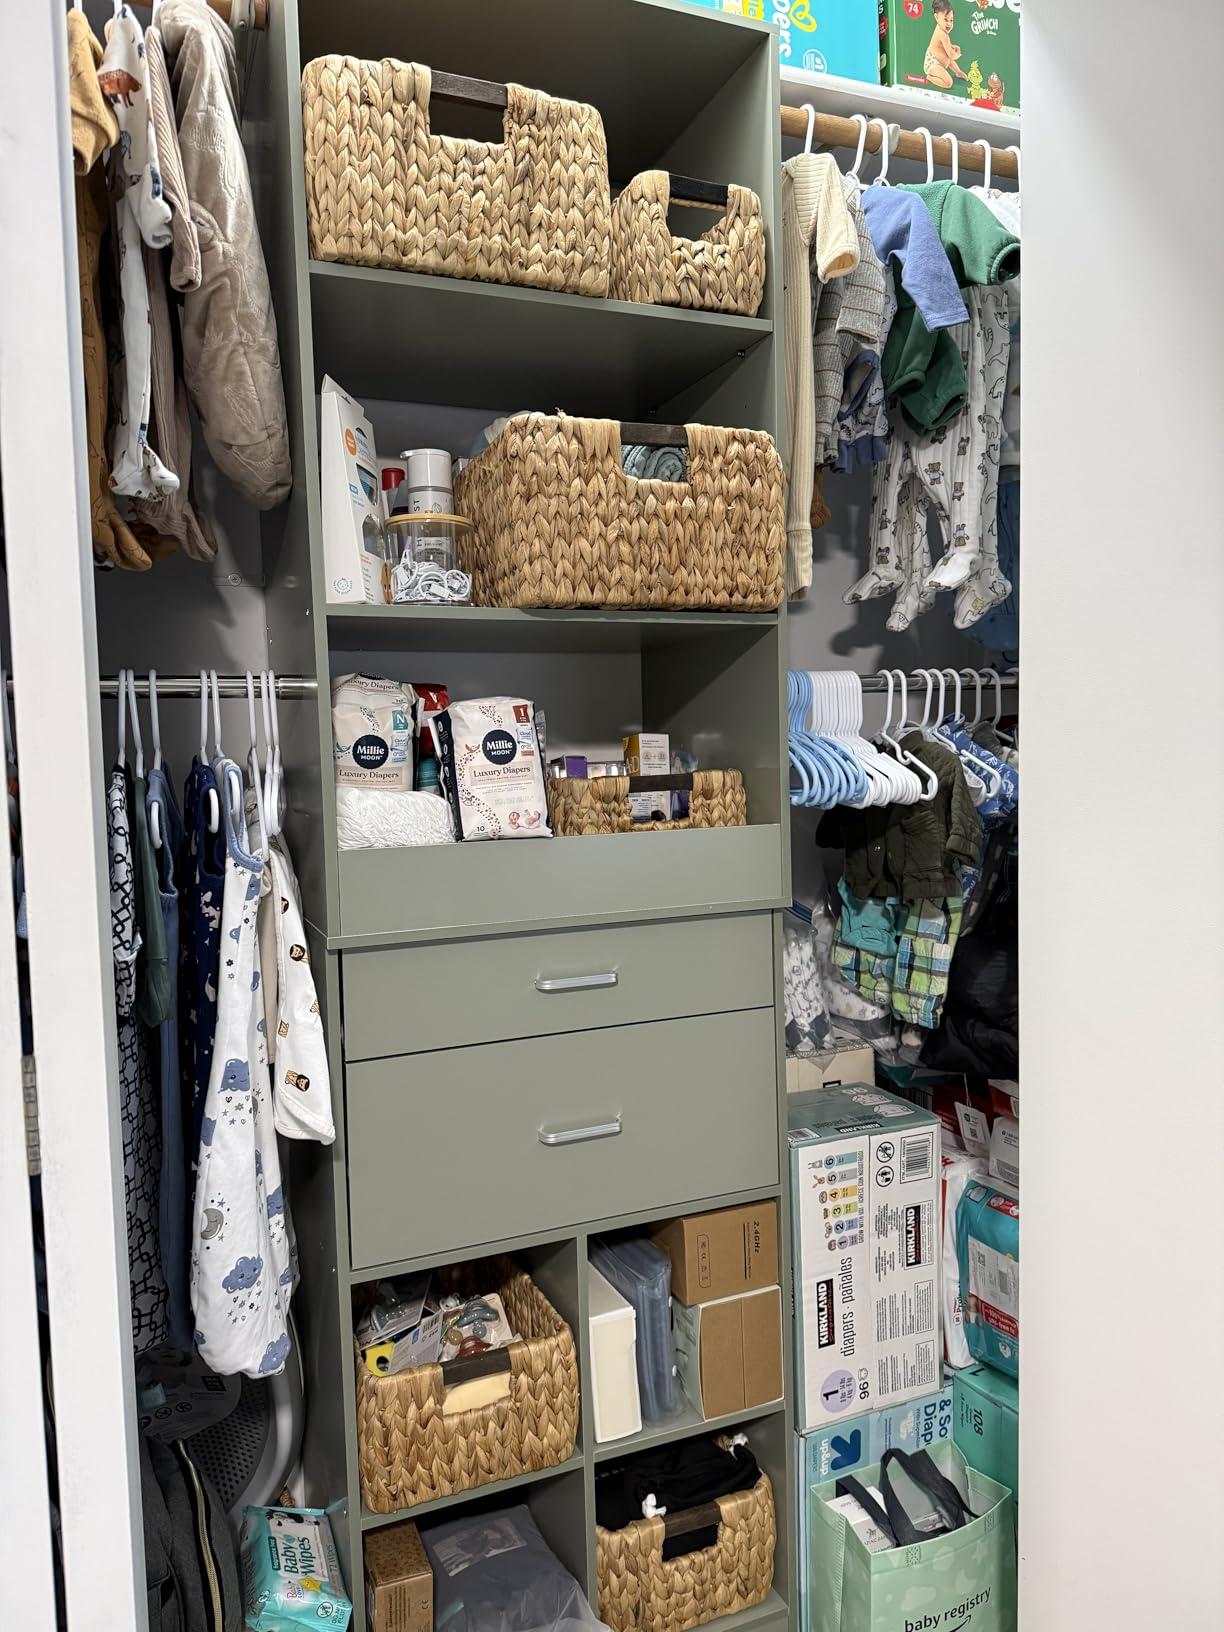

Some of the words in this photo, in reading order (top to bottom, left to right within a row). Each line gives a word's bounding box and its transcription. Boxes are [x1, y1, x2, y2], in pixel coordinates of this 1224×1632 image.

[908, 3, 919, 14] 74
[971, 10, 985, 21] The
[971, 18, 999, 35] GRINCH
[370, 681, 400, 690] Diapers
[396, 713, 405, 724] N
[519, 707, 525, 717] 1
[356, 745, 385, 755] Millie
[486, 740, 513, 751] Millie
[339, 769, 368, 780] Luxury
[369, 771, 400, 780] Diapers
[473, 768, 502, 778] Luxury
[502, 765, 531, 776] Diapers
[840, 1122, 881, 1133] KIRKLAND
[825, 1158, 834, 1166] 6
[828, 1174, 837, 1182] 5
[830, 1191, 838, 1199] 4
[833, 1207, 841, 1215] 3
[836, 1223, 844, 1231] 2
[906, 1208, 916, 1264] KIRKLAND
[838, 1256, 856, 1305] pañales
[817, 1282, 829, 1345] KIRKLAND
[840, 1311, 857, 1357] diapers
[823, 1388, 839, 1401] 1
[859, 1381, 870, 1400] 96
[939, 1399, 951, 1413] &
[921, 1403, 937, 1446] Diap
[938, 1414, 951, 1439] So
[973, 1408, 983, 1436] 108
[819, 1438, 831, 1475] up&up
[281, 1541, 300, 1574] Baby
[296, 1536, 317, 1576] Wipes
[905, 1614, 941, 1632] baby
[944, 1587, 991, 1621] registry
